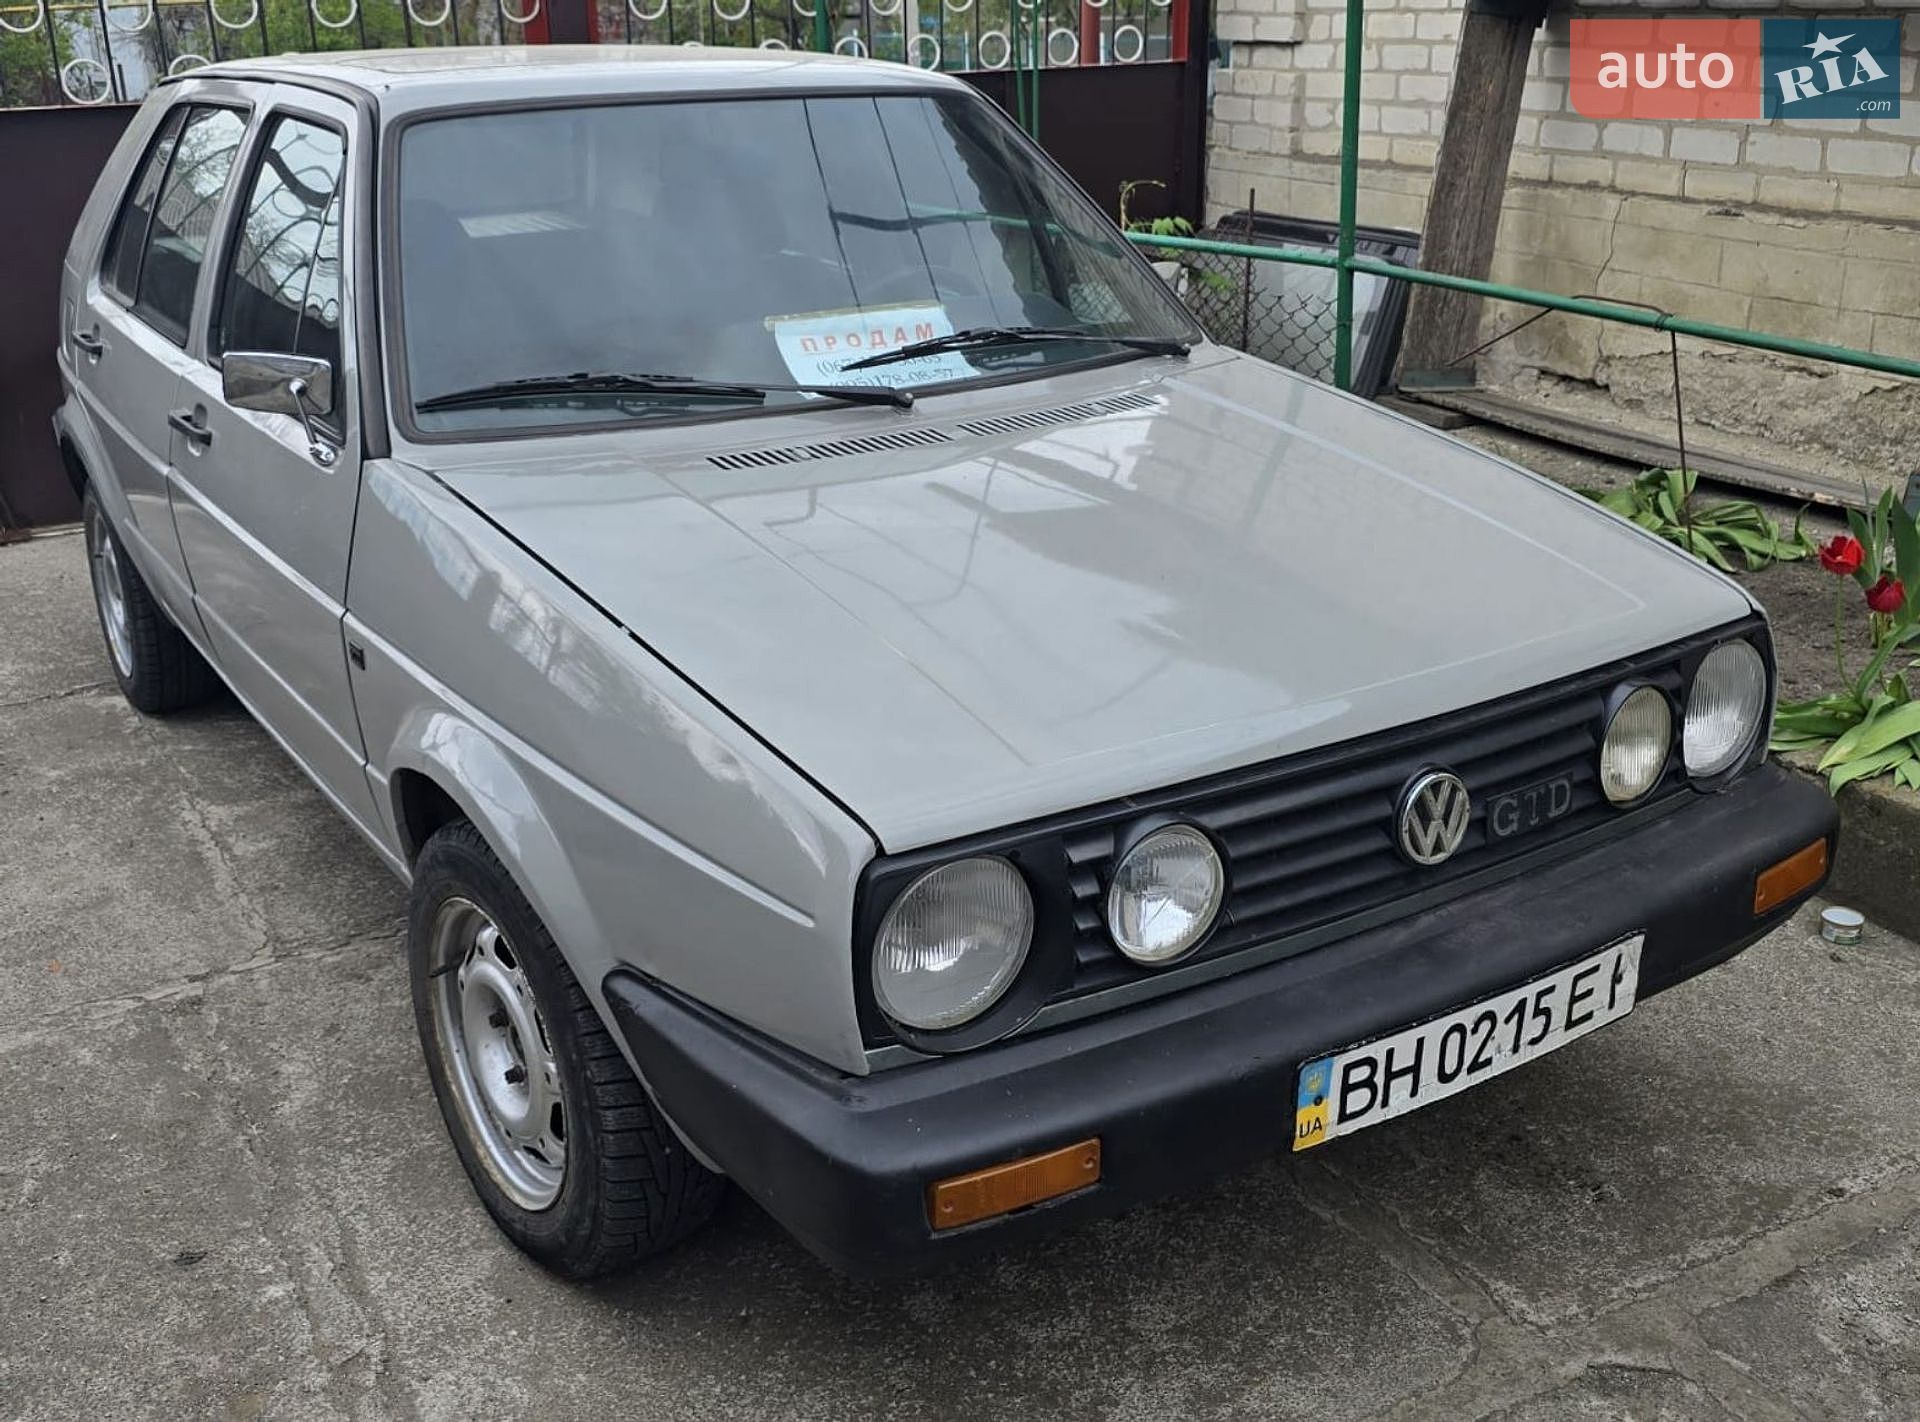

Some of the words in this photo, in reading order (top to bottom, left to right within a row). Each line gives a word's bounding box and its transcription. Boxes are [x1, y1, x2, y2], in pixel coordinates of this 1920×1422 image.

[801, 322, 935, 353] ПРОДАМ
[1493, 778, 1572, 837] GTD
[1299, 1116, 1323, 1139] UA
